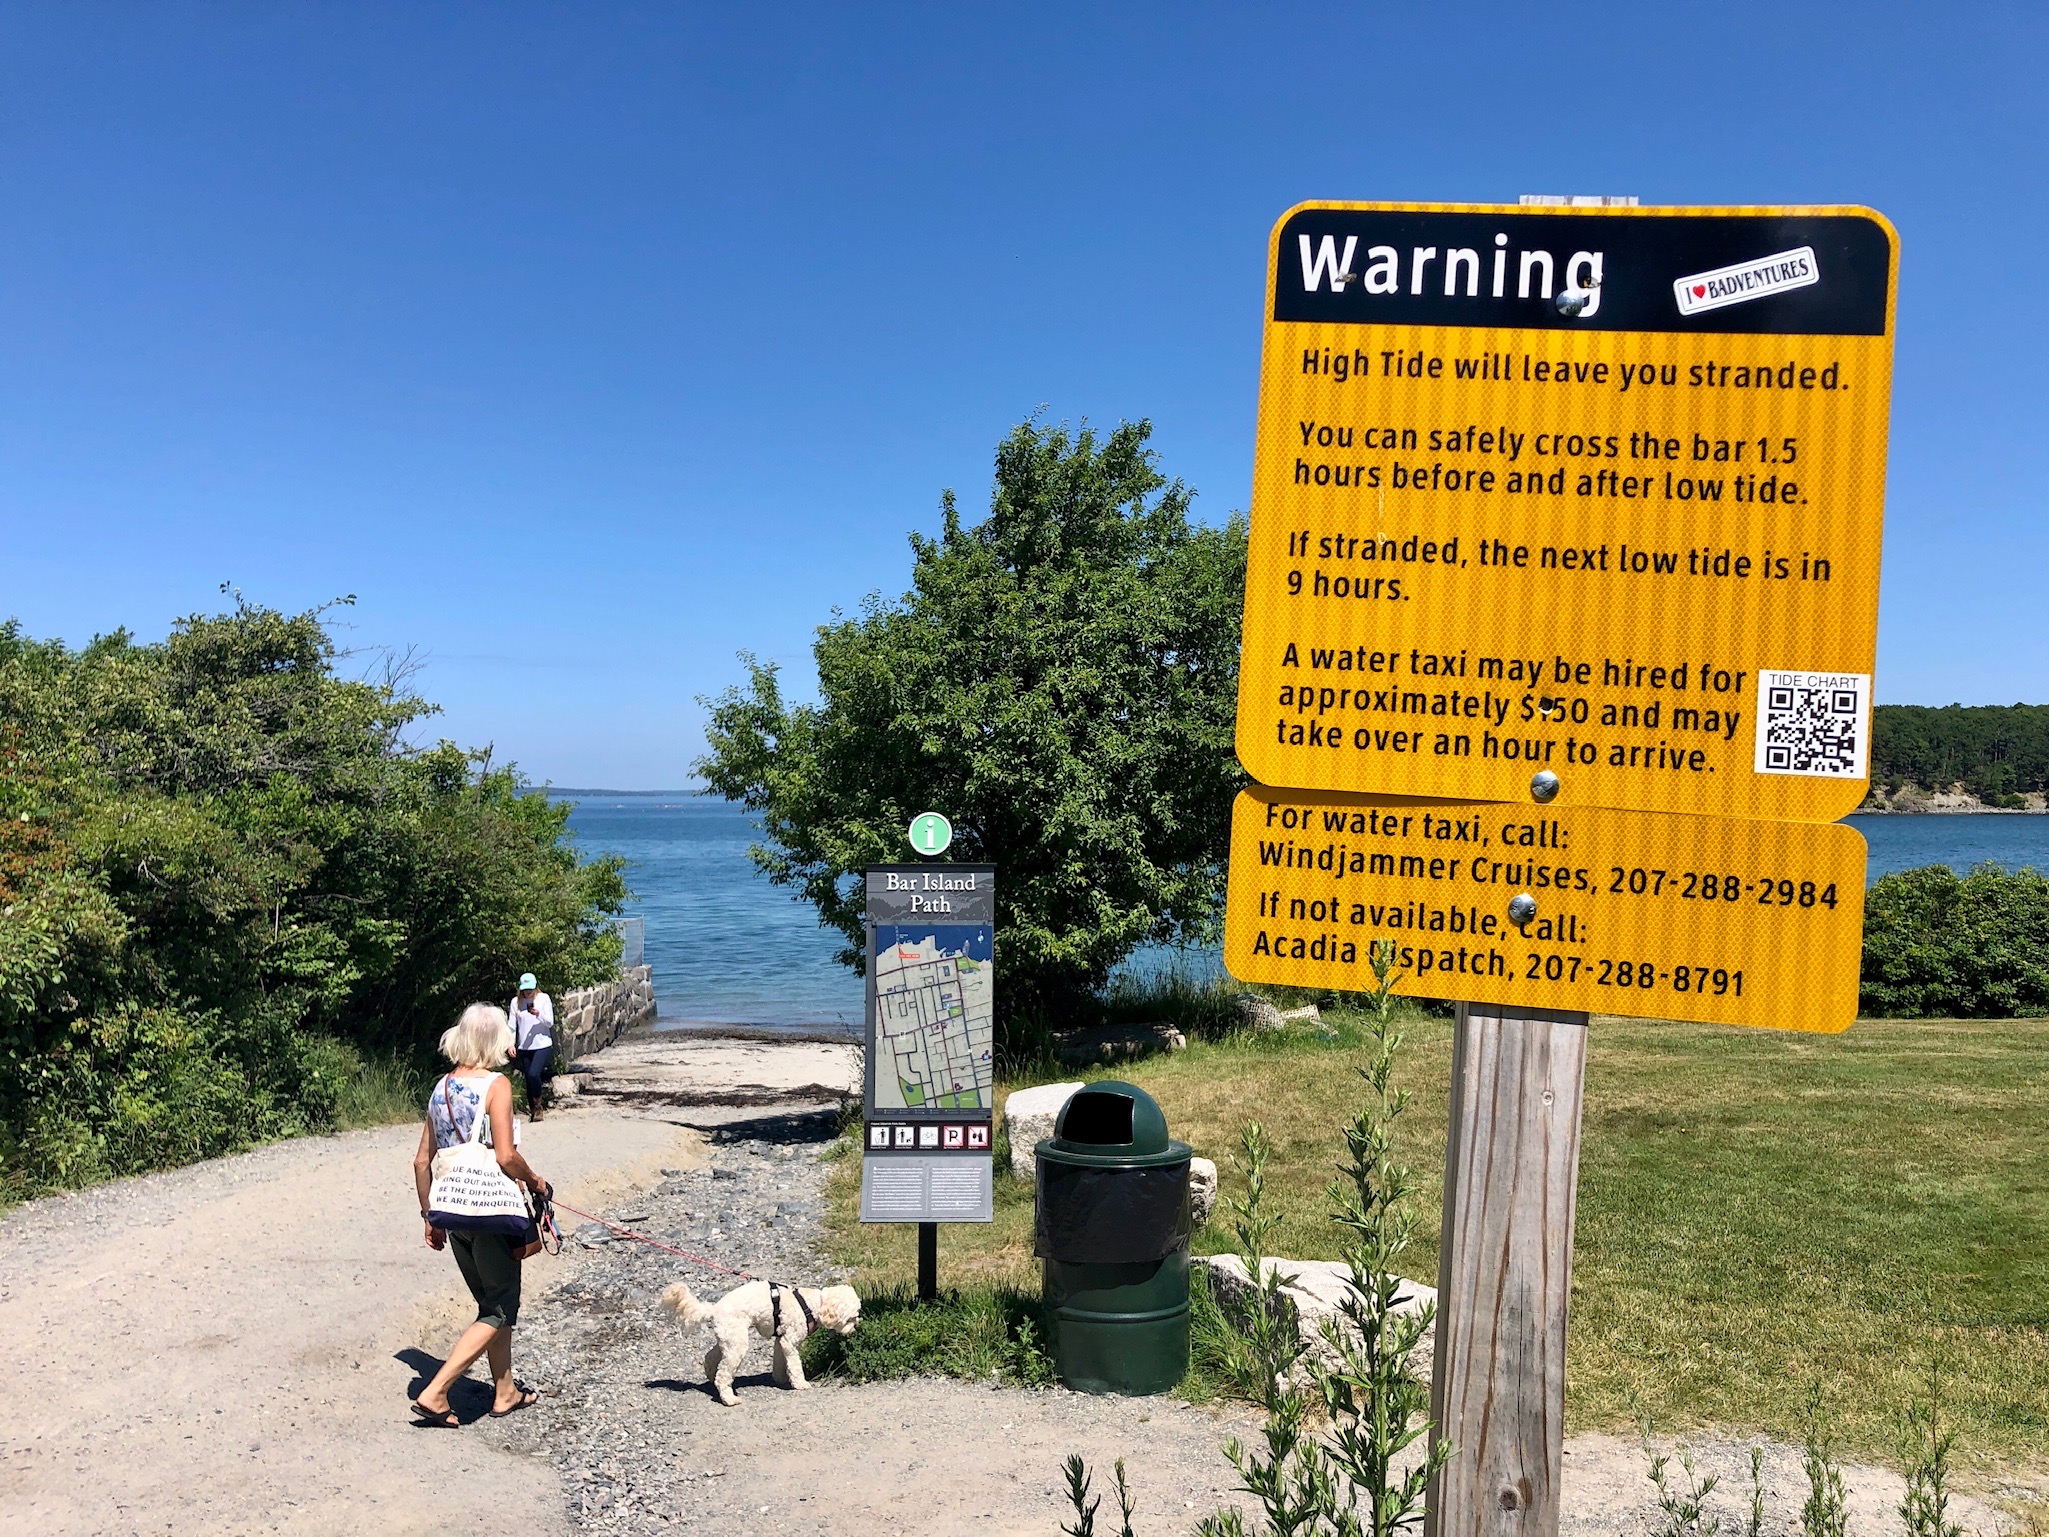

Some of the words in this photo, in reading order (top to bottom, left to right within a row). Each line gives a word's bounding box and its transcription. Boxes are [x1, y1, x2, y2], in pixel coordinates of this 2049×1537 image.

[1298, 232, 1604, 318] Warning
[1707, 257, 1809, 299] BADVENTURES
[1302, 349, 1369, 383] High
[1380, 351, 1443, 379] Tide
[1454, 354, 1512, 382] will
[1523, 354, 1609, 385] leave
[1619, 363, 1677, 392] you
[1688, 361, 1849, 391] stranded.
[1299, 421, 1353, 450] You
[1364, 428, 1417, 450] can
[1428, 425, 1525, 462] safely
[1534, 433, 1619, 459] cross
[1629, 432, 1681, 462] the
[1692, 433, 1747, 464] bar
[1757, 437, 1798, 466] 1.5
[1294, 457, 1381, 489] hours
[1392, 461, 1496, 492] before
[1506, 467, 1565, 496] and
[1576, 470, 1654, 500] after
[1664, 472, 1724, 501] low
[1734, 475, 1808, 505] tide.
[1289, 530, 1310, 558] If
[1318, 533, 1468, 570] stranded,
[1479, 538, 1529, 568] the
[1541, 545, 1609, 571] next
[1619, 544, 1678, 574] low
[1688, 547, 1752, 578] tide
[1763, 550, 1789, 579] is
[1801, 552, 1831, 583] in
[1287, 570, 1303, 596] 9
[1313, 569, 1411, 602] hours.
[1281, 642, 1300, 668] A
[1310, 645, 1401, 674] water
[1409, 649, 1467, 677] taxi
[1477, 657, 1544, 690] may
[1554, 655, 1592, 685] be
[1603, 658, 1688, 691] hired
[1699, 663, 1748, 694] for
[1768, 673, 1803, 687] TIDE
[1807, 675, 1860, 689] CHART
[1278, 685, 1511, 728] approximately
[1600, 701, 1661, 729] and
[1672, 707, 1742, 741] may
[1276, 718, 1343, 750] take
[1354, 728, 1424, 754] over
[1433, 733, 1472, 757] an
[1482, 730, 1557, 763] hour
[1566, 736, 1598, 766] to
[1608, 740, 1716, 774] arrive.
[1265, 803, 1313, 832] For
[1323, 809, 1414, 839] water
[1422, 812, 1491, 849] taxi,
[1501, 819, 1570, 851] call:
[886, 872, 918, 891] Bar
[922, 872, 976, 892] Island
[1258, 840, 1461, 882] Windjammer
[1471, 854, 1599, 895] Cruises,
[1609, 866, 1840, 911] 207-288-2984
[910, 894, 952, 913] Path
[1259, 890, 1280, 918] If
[1289, 896, 1341, 923] not
[1350, 900, 1508, 942] available,
[1252, 930, 1356, 964] Acadia
[1525, 953, 1744, 997] 207-288-8791
[438, 1185, 449, 1193] BE
[450, 1186, 467, 1195] THE
[463, 1178, 480, 1187] OUT
[466, 1167, 483, 1177] AND
[436, 1195, 449, 1203] WE
[450, 1196, 468, 1206] ARE
